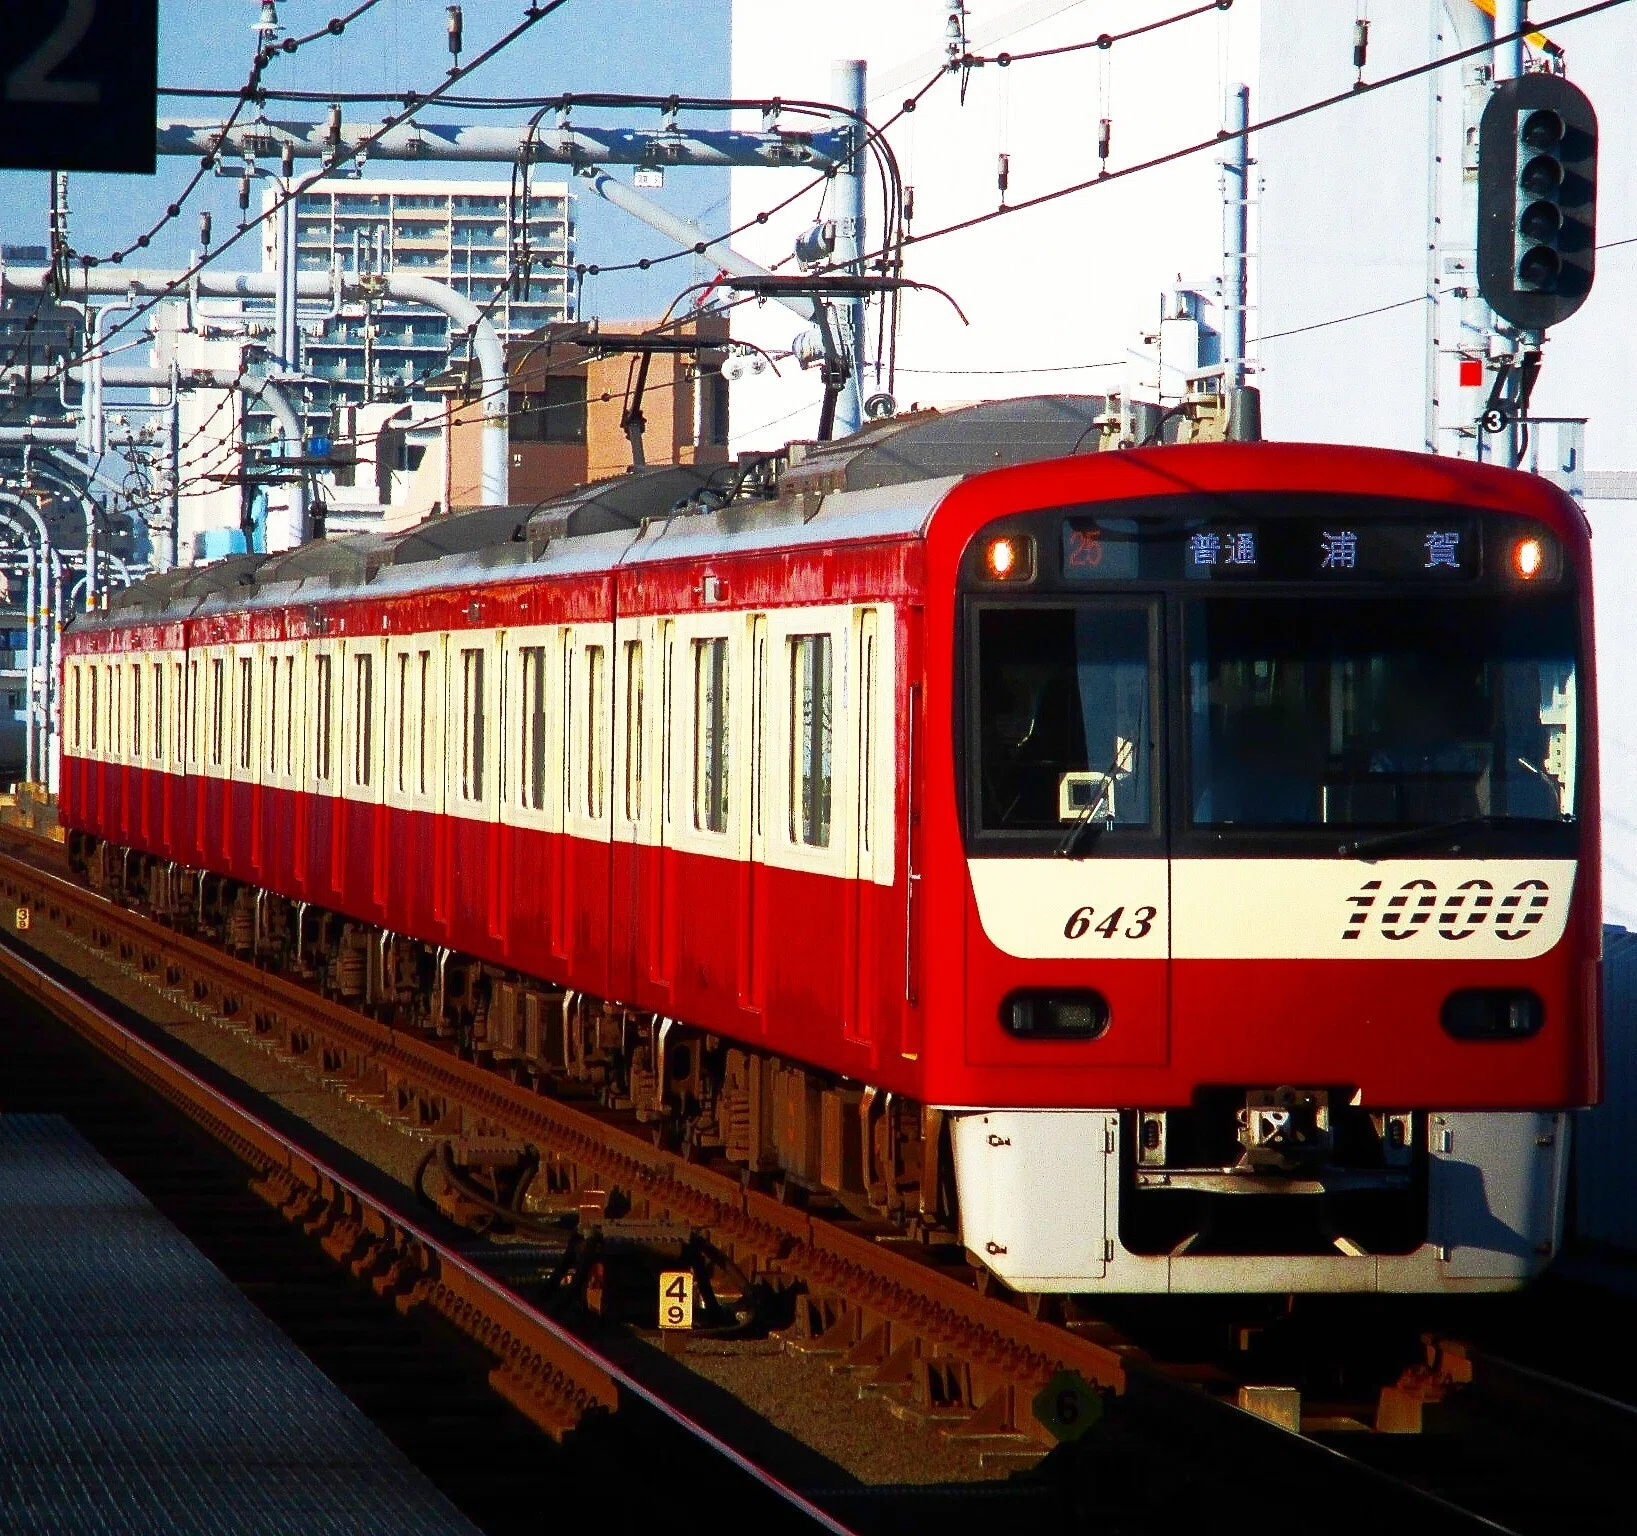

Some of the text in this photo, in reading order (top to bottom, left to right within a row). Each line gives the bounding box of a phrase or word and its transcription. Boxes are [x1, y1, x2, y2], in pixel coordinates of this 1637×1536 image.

[5, 0, 101, 102] 2
[1488, 410, 1501, 430] 3
[1069, 529, 1102, 567] 25
[1189, 532, 1256, 564] 普通
[1063, 906, 1157, 939] 643
[1341, 879, 1549, 940] 1000
[665, 1275, 688, 1304] 4
[667, 1305, 685, 1325] 9
[1056, 1389, 1079, 1425] 6
